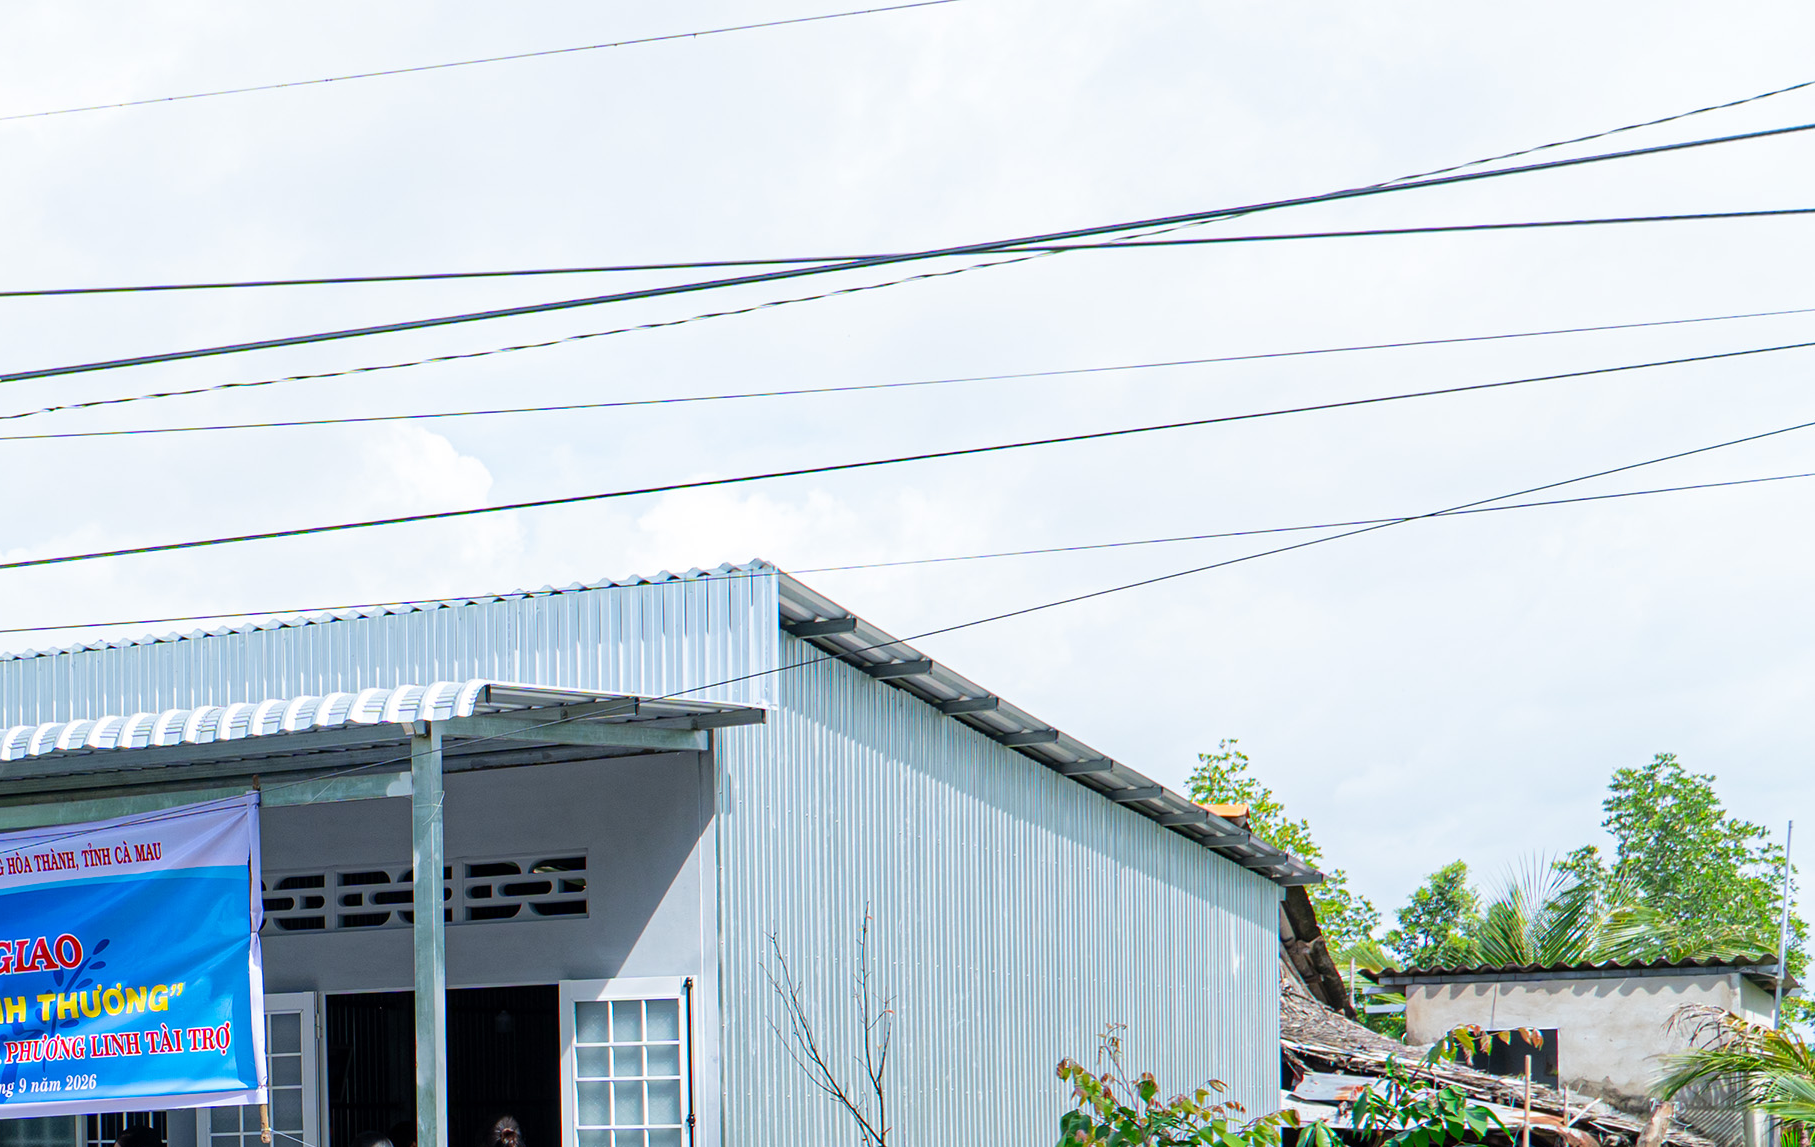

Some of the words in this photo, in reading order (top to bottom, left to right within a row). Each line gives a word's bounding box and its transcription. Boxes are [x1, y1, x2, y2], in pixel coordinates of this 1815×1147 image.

[6, 851, 33, 875] HÒA
[34, 848, 79, 871] THÀNH,
[81, 842, 112, 867] TỈNH
[114, 840, 133, 864] CÀ
[134, 842, 162, 862] MAU
[4, 1033, 87, 1064] PHƯƠNG
[90, 1031, 142, 1059] LINH
[144, 1023, 183, 1055] TÀI
[187, 1020, 232, 1056] TRỢ
[18, 1078, 27, 1094] 9
[30, 1077, 61, 1093] năm
[65, 1074, 97, 1091] 2026
